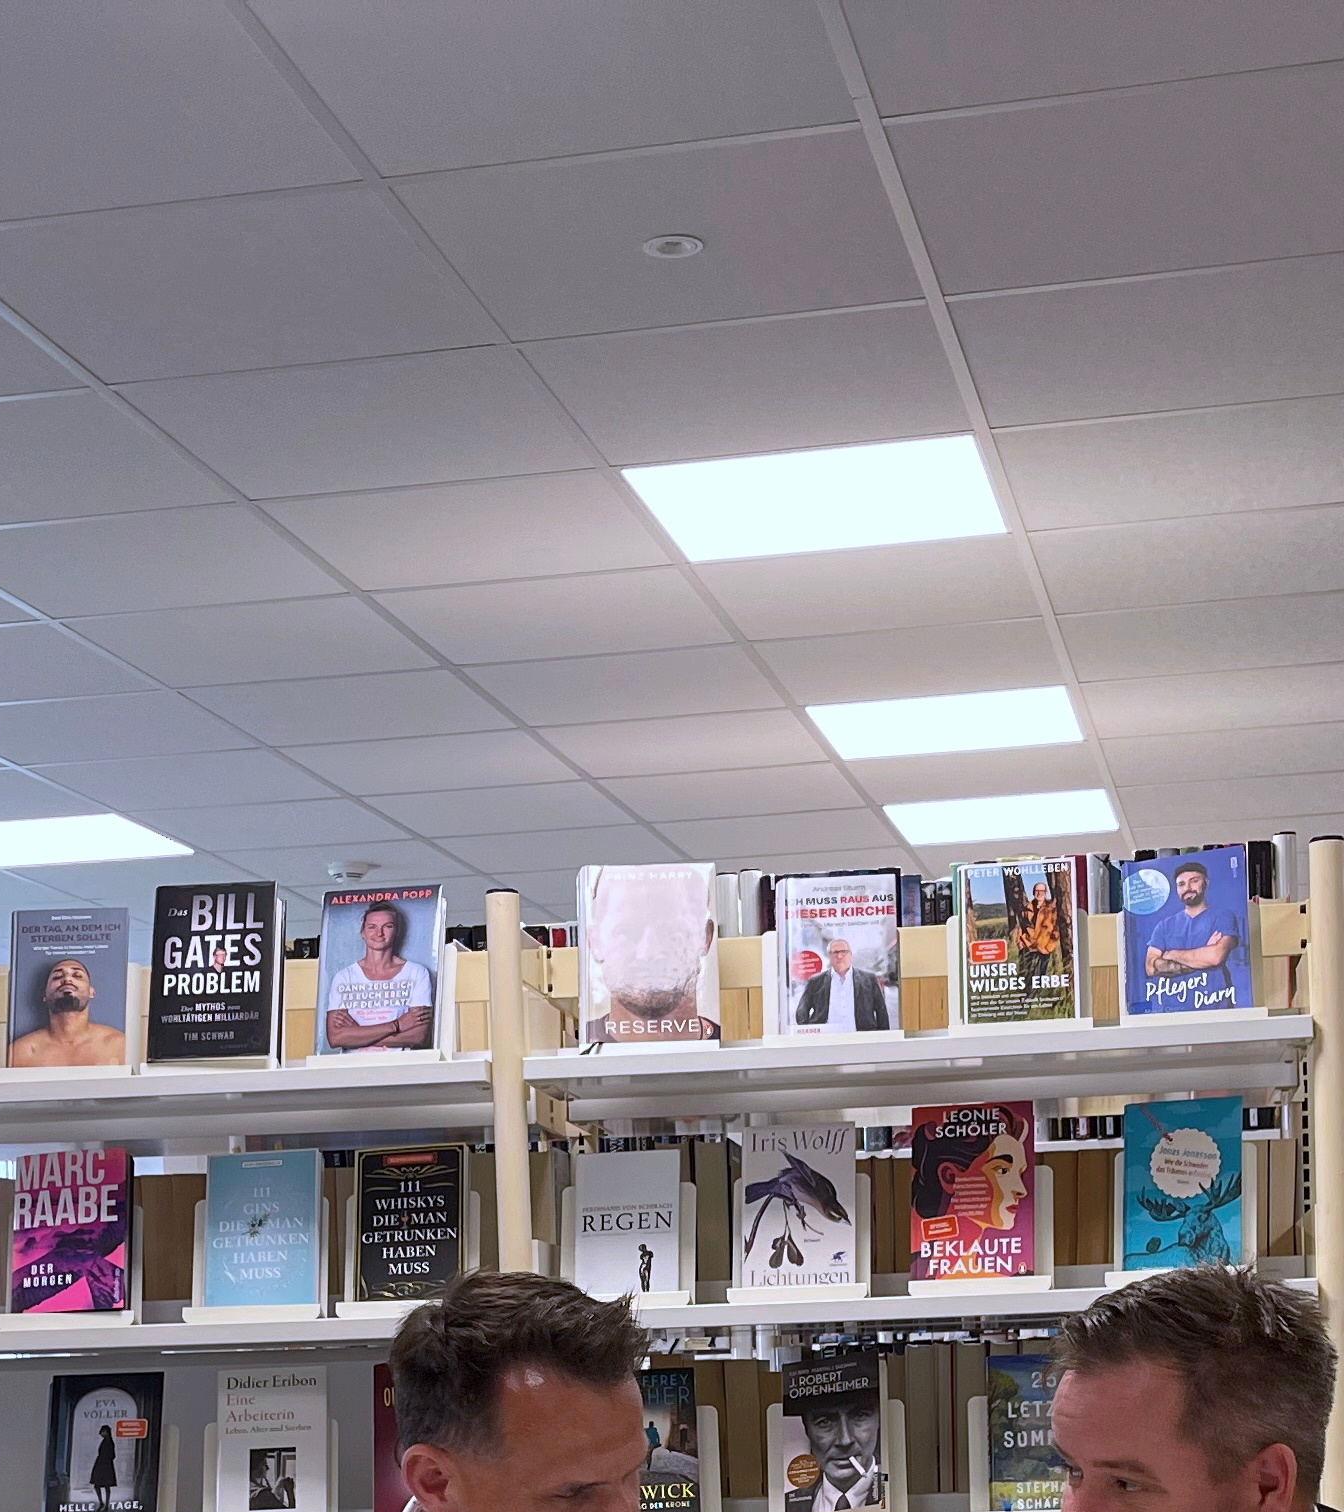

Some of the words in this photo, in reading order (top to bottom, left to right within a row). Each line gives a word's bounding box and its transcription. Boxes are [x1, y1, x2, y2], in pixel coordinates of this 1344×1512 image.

[606, 872, 644, 880] PRINZ
[649, 871, 693, 880] HARRY
[968, 868, 999, 879] PETER
[1004, 863, 1069, 876] WOHLLEBEN
[332, 893, 399, 905] ALEXANDRA
[403, 890, 432, 899] POPP
[806, 897, 837, 905] MUSS
[841, 895, 869, 904] RAUS
[872, 894, 894, 902] AUS
[168, 907, 188, 917] Das
[191, 893, 264, 931] BILL
[841, 905, 895, 917] KIRCHE
[22, 926, 40, 934] DER
[65, 924, 78, 932] AN
[82, 924, 102, 932] DEM
[105, 923, 120, 931] ICH
[31, 934, 74, 943] STERBEN
[77, 933, 111, 941] SOLLTE
[164, 933, 262, 969] GATES
[970, 963, 1017, 978] UNSER
[163, 971, 260, 997] PROBLEM
[338, 984, 365, 992] DANN
[970, 977, 1025, 992] WILDES
[1032, 975, 1069, 989] ERBE
[1146, 973, 1208, 1005] Pflegers
[357, 992, 381, 1000] EUCH
[384, 999, 411, 1007] PLATZ
[1194, 987, 1236, 1008] Diary
[195, 1002, 225, 1011] MYTHOS
[161, 1012, 212, 1023] WOHLTÄTIGEN
[215, 1011, 259, 1022] MILLIARDÄR
[605, 1019, 701, 1035] RESERVE
[184, 1033, 198, 1041] TIM
[201, 1031, 235, 1041] SCHWAB
[943, 1108, 1000, 1123] LEONIE
[935, 1121, 1007, 1138] SCHÖLER
[752, 1133, 787, 1153] Iris
[793, 1128, 849, 1155] Wolff
[1158, 1146, 1180, 1156] Jonas
[1183, 1147, 1217, 1160] Jonasson
[15, 1148, 105, 1192] MARC
[253, 1187, 271, 1197] 111
[399, 1181, 421, 1193] 111
[13, 1184, 119, 1231] RAABE
[243, 1202, 280, 1215] GINS
[375, 1195, 445, 1210] WHISKYS
[219, 1221, 245, 1233] DIE
[268, 1217, 304, 1229] MAN
[372, 1214, 399, 1227] DIE
[411, 1211, 447, 1225] MAN
[582, 1211, 672, 1232] REGEN
[213, 1233, 309, 1249] GETRUNKEN
[362, 1227, 457, 1244] GETRUNKEN
[382, 1245, 436, 1259] HABEN
[921, 1238, 1022, 1258] BEKLAUTE
[233, 1250, 287, 1264] HABEN
[31, 1264, 54, 1275] DER
[240, 1267, 281, 1280] MUSS
[388, 1262, 430, 1275] MUSS
[929, 1256, 1013, 1276] FRAUEN
[23, 1273, 73, 1288] MORGEN
[751, 1270, 850, 1287] Lichtungen
[226, 1377, 269, 1390] Didier
[272, 1373, 317, 1387] Eribon
[642, 1374, 689, 1387] FFREY
[789, 1376, 796, 1388] J.
[799, 1371, 843, 1385] ROBERT
[1031, 1372, 1056, 1388] 25
[789, 1377, 869, 1399] OPPENHEIMER
[96, 1399, 116, 1408] EVA
[226, 1393, 256, 1407] Eine
[83, 1409, 128, 1419] VÖLLER
[226, 1408, 295, 1423] Arbeiterin
[1008, 1402, 1054, 1418] LETZ
[225, 1427, 248, 1435] Leben,
[250, 1425, 268, 1433] Alter
[1003, 1430, 1054, 1447] SOM
[640, 1483, 695, 1500] WICK
[1016, 1481, 1065, 1494] STEPHA
[60, 1503, 95, 1512] HELLE
[110, 1501, 143, 1510] TAGE,
[1016, 1496, 1062, 1510] SCHÄF
